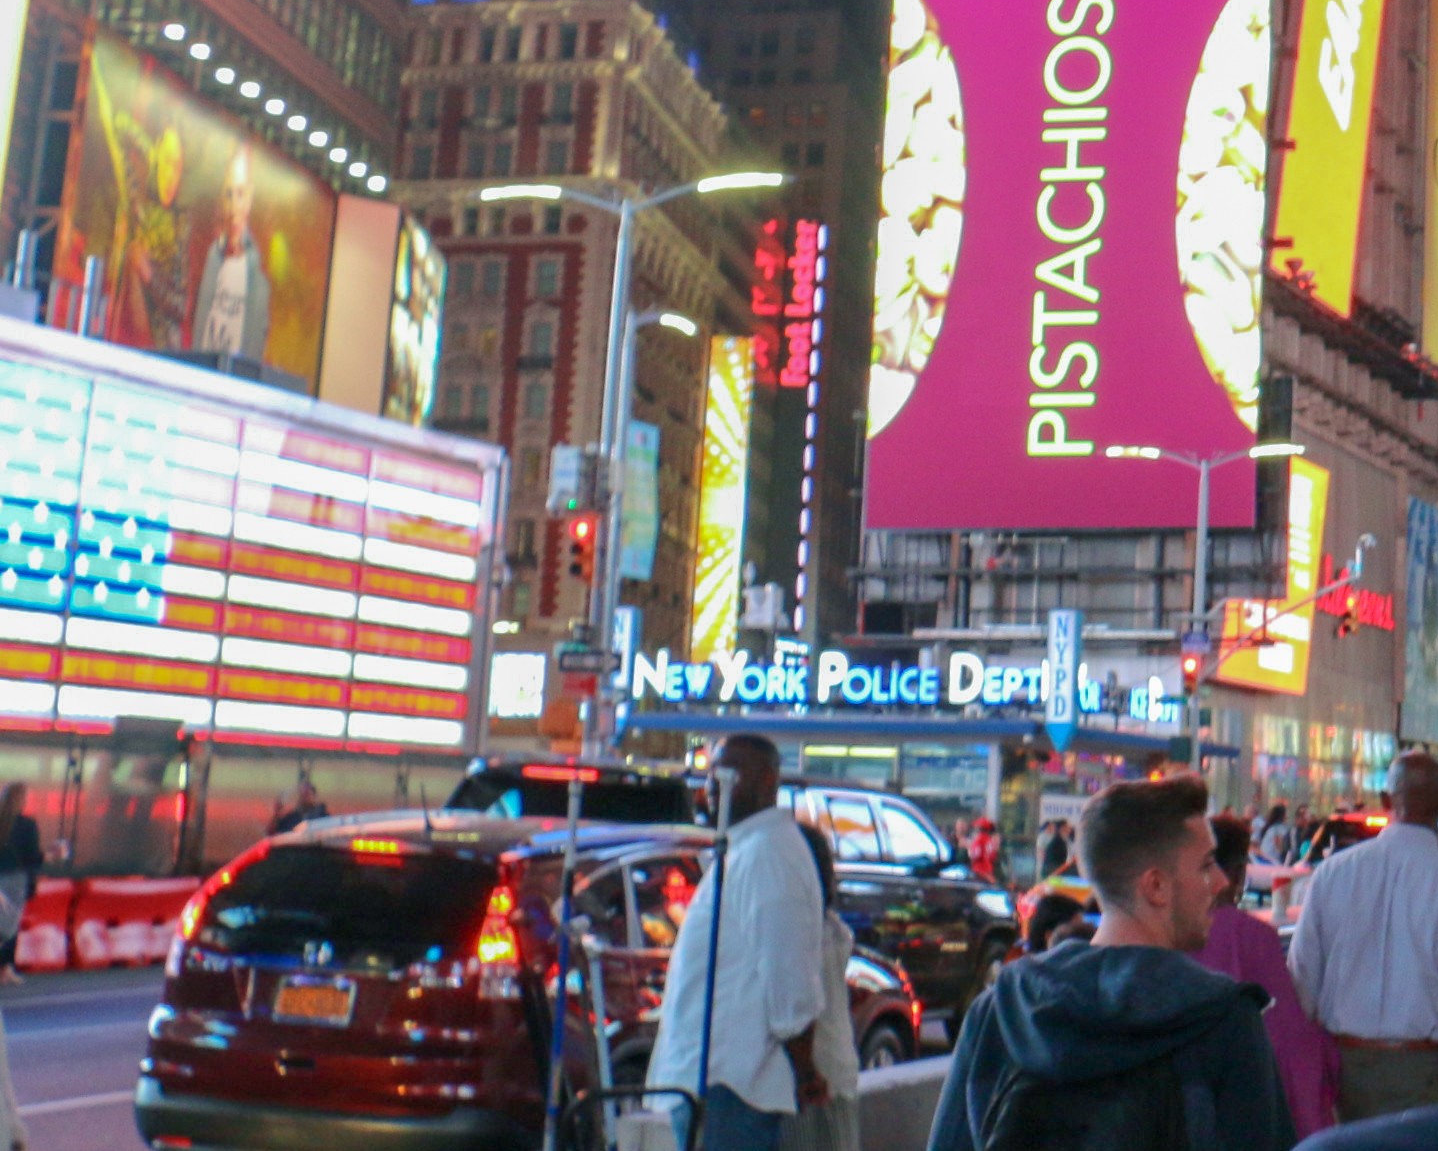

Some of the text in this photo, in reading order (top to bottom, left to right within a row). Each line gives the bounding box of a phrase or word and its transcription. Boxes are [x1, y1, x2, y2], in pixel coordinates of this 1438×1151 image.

[632, 647, 713, 702] NEW
[709, 649, 810, 703] YORK
[817, 649, 940, 705] POLICE
[1053, 615, 1071, 718] NYPD
